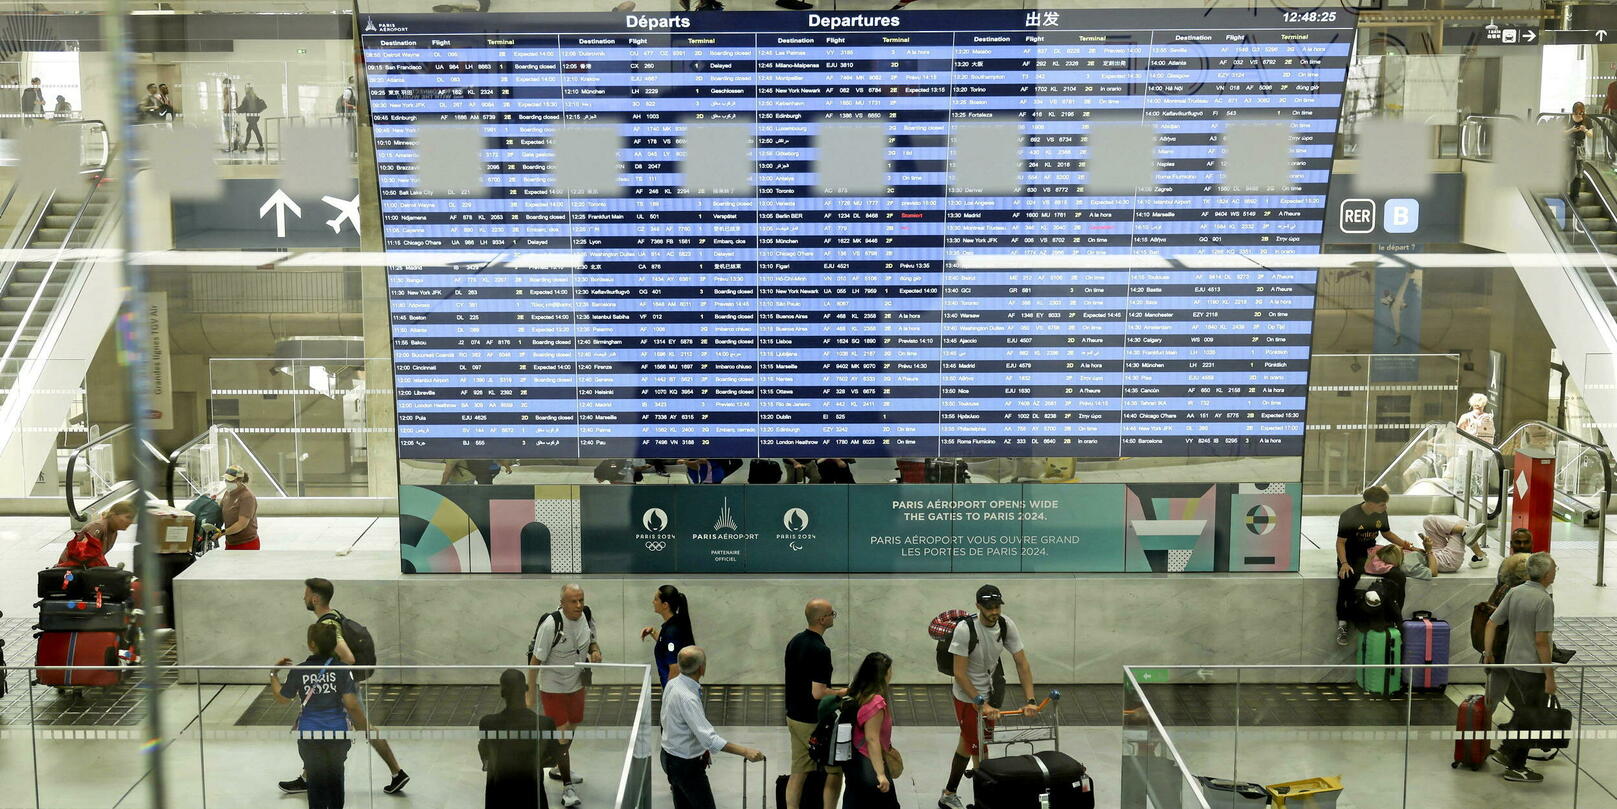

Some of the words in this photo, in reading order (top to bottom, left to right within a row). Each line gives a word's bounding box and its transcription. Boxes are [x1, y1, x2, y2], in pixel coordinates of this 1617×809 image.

[626, 15, 690, 30] Départs
[809, 14, 899, 29] Departures
[1026, 12, 1059, 26] 出发
[1283, 12, 1336, 22] 12:48:25
[1345, 210, 1370, 222] RER
[1394, 207, 1408, 225] B
[892, 501, 923, 509] PARIS
[927, 499, 986, 509] AÉROPORT
[990, 500, 1025, 509] OPENS
[1030, 500, 1058, 508] WIDE
[1018, 512, 1047, 520] 2024.
[904, 535, 963, 544] AÉROPORT
[1000, 536, 1037, 544] OUVRE
[924, 548, 966, 556] PORTES
[1020, 548, 1048, 556] 2024.
